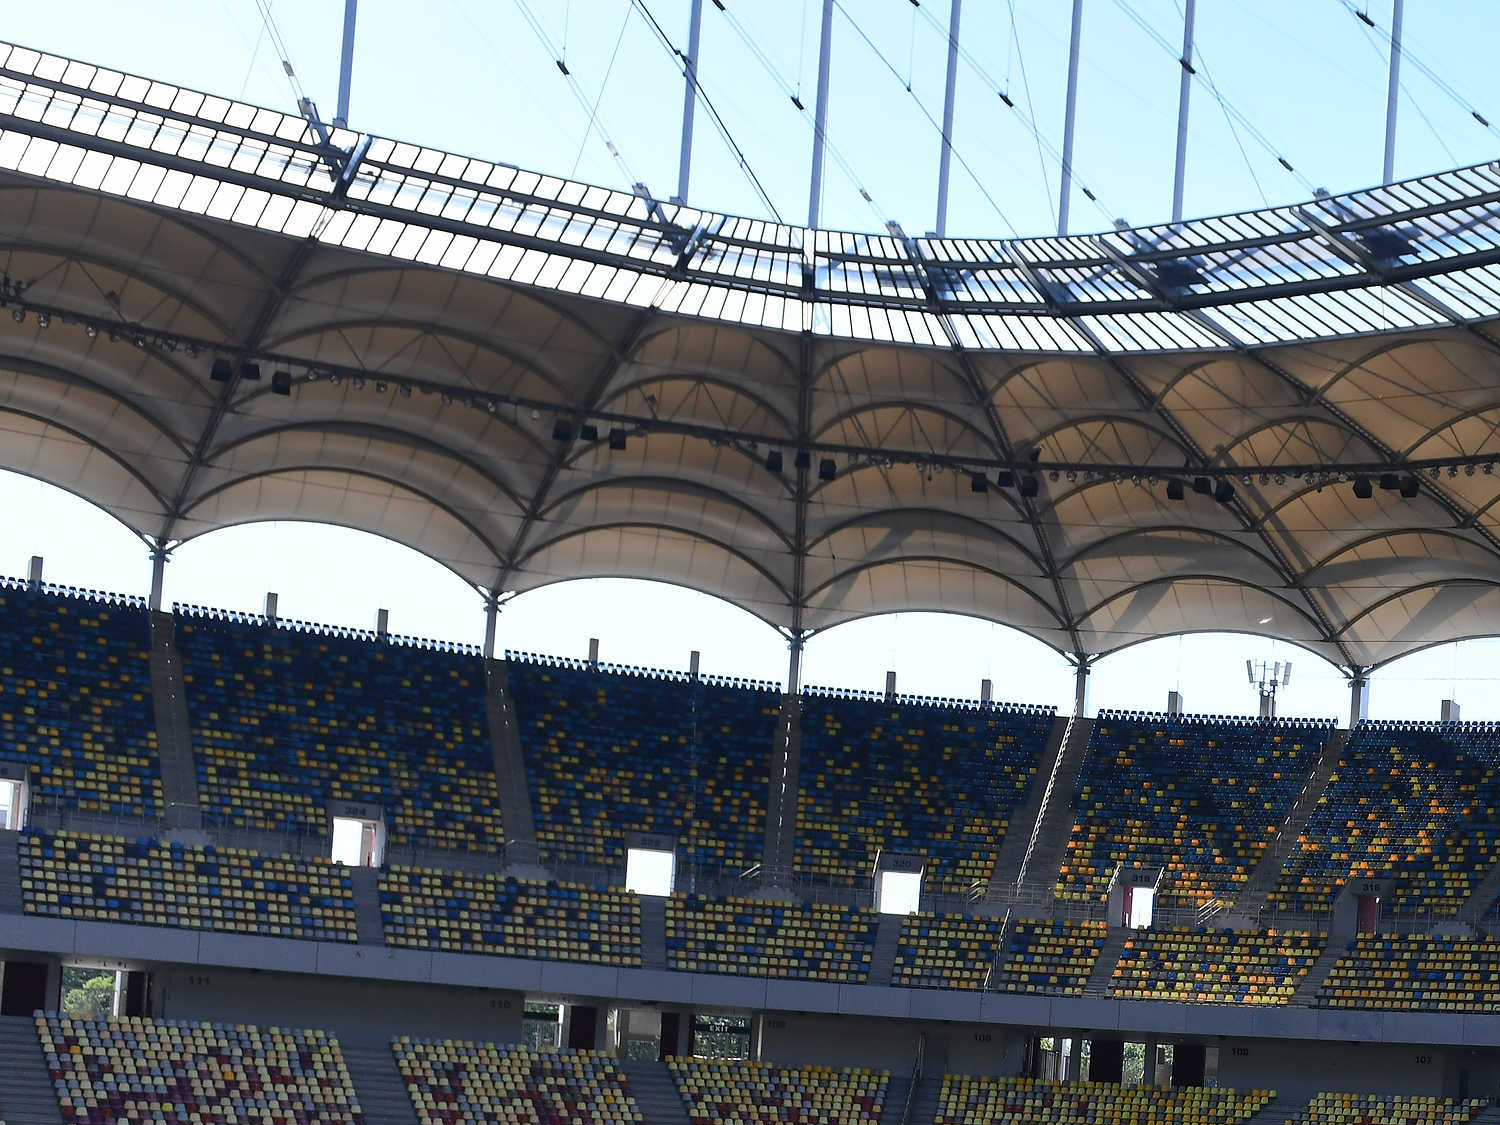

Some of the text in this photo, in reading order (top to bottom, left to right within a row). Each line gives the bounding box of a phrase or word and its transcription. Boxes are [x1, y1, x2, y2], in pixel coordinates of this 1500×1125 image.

[892, 859, 912, 868] 320
[1132, 874, 1150, 883] 318
[1362, 883, 1381, 892] 316
[189, 976, 210, 986] 111
[490, 1000, 511, 1009] 110
[766, 1020, 786, 1029] 109
[972, 1033, 992, 1042] 108
[1231, 1047, 1249, 1056] 108
[1414, 1056, 1432, 1065] 107
